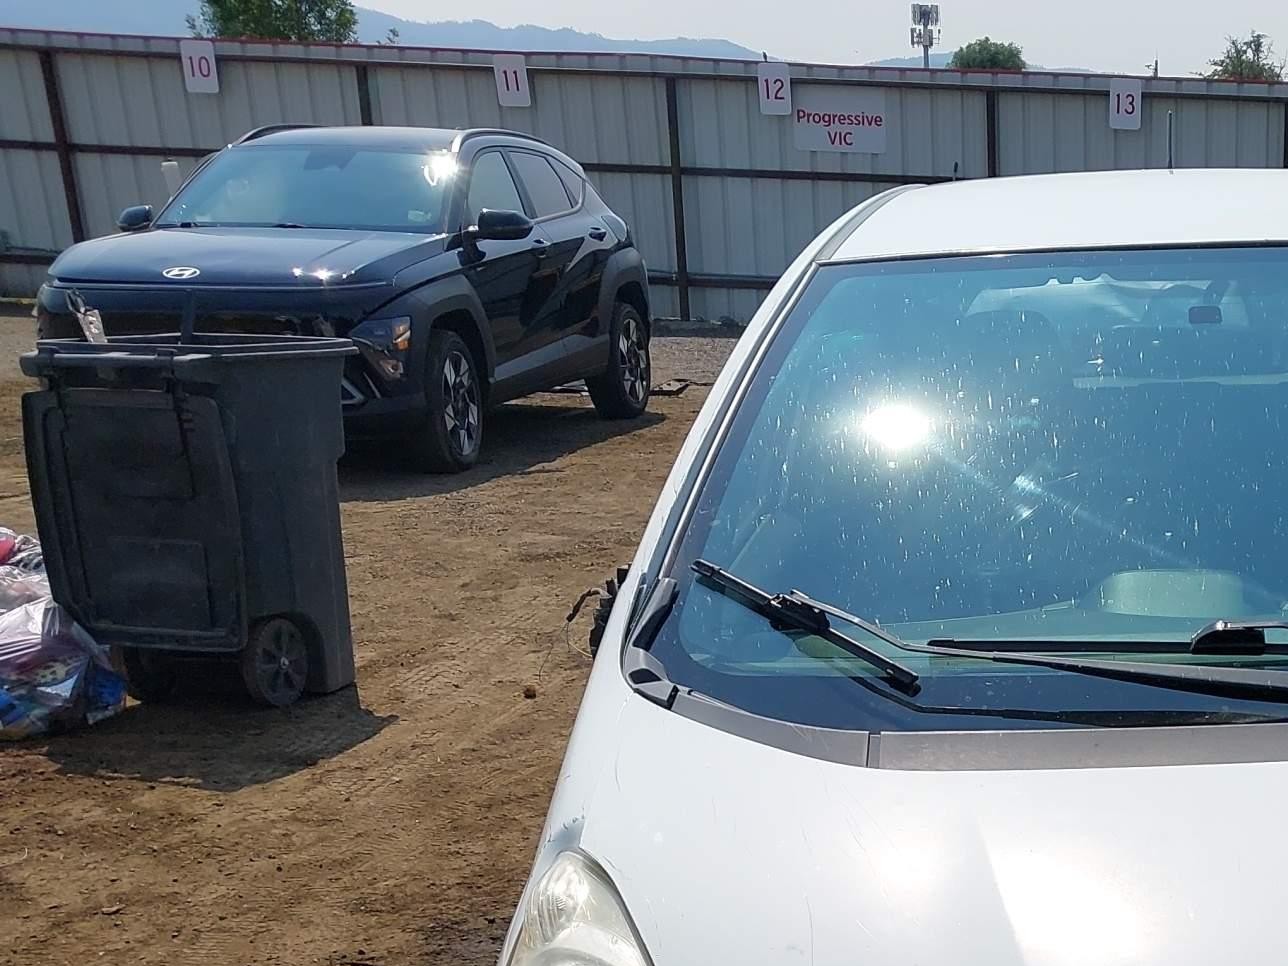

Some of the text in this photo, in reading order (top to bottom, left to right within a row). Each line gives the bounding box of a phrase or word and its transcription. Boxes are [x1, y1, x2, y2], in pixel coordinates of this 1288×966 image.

[188, 55, 211, 78] 10
[503, 70, 520, 92] 11
[764, 78, 785, 100] 12
[1115, 93, 1136, 115] 13
[796, 109, 884, 128] Progressive
[827, 131, 854, 147] VIC
